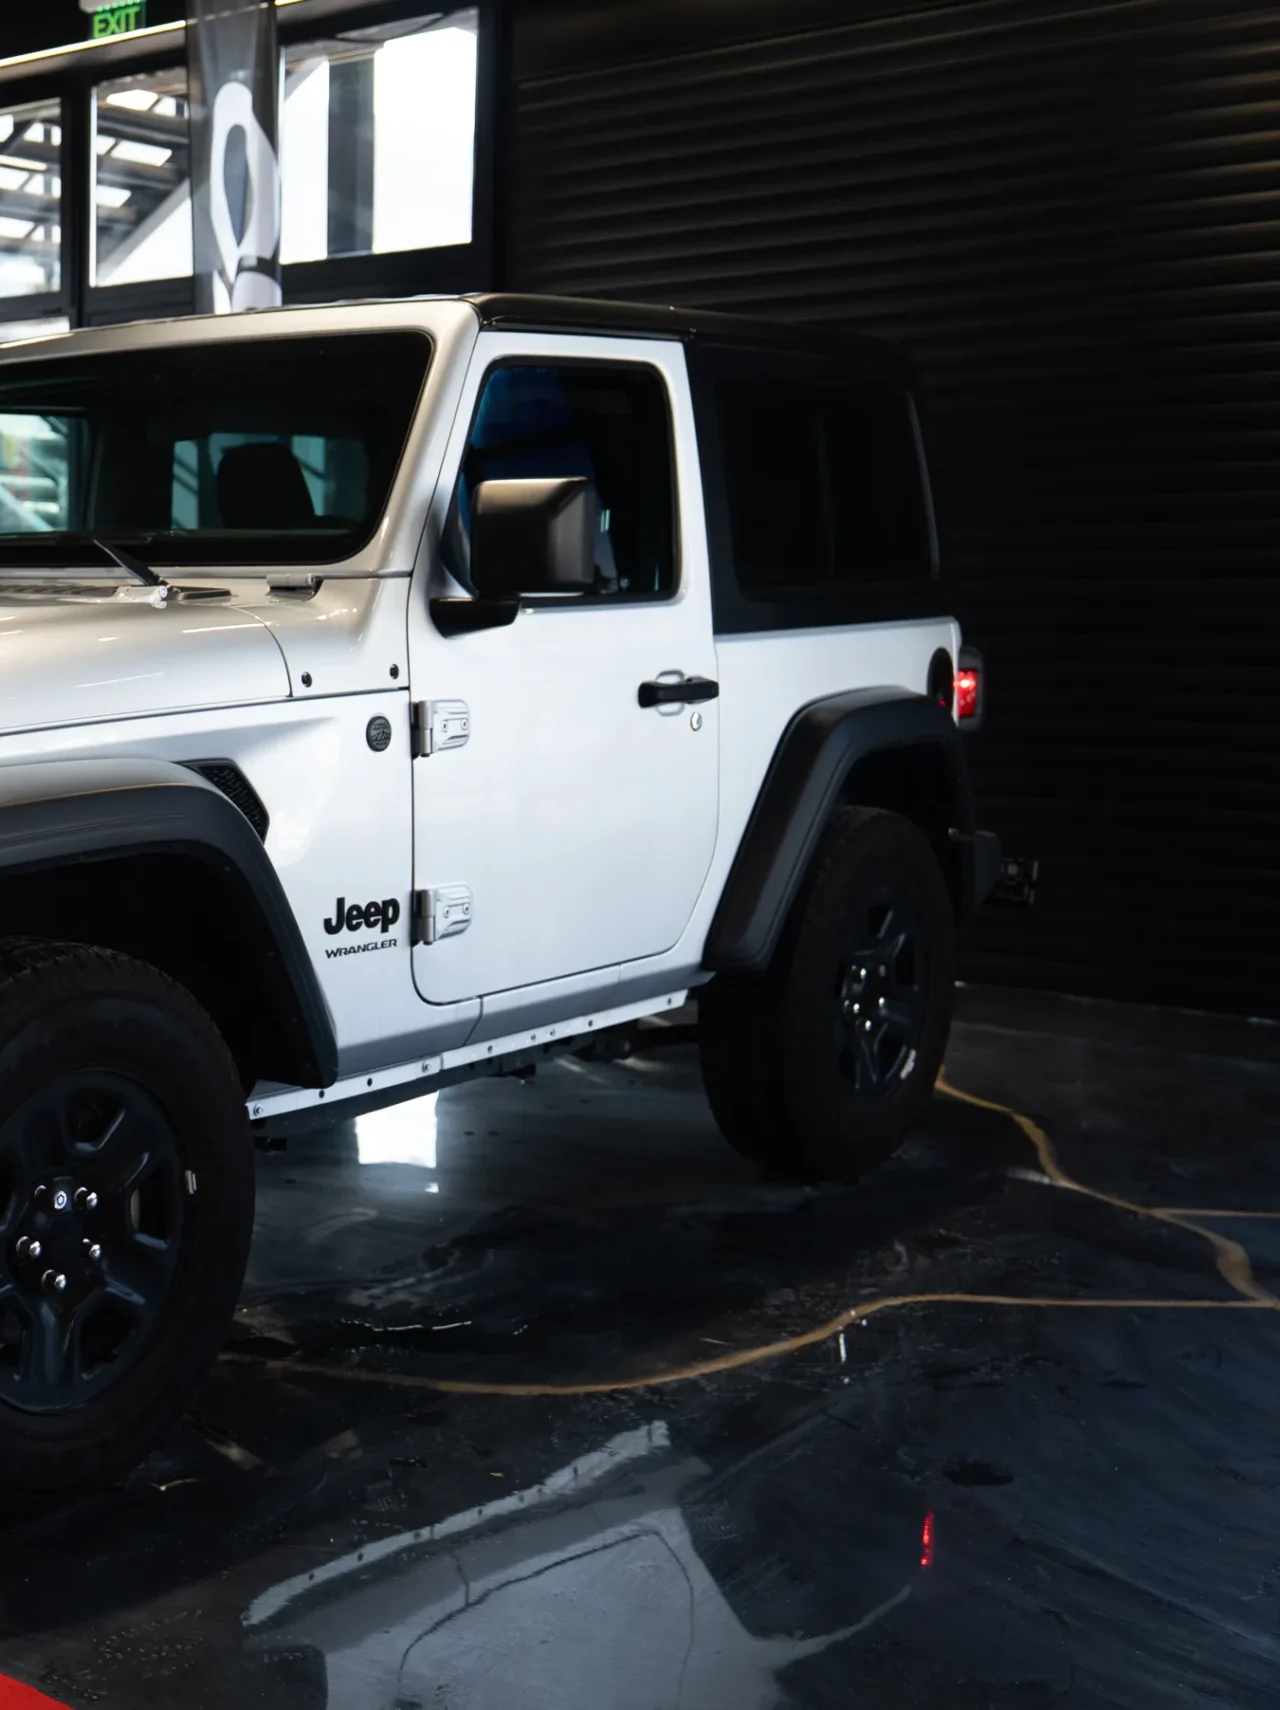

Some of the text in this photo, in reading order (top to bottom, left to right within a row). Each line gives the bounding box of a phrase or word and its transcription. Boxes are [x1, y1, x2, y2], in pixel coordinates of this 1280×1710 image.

[93, 5, 141, 39] EXIT
[323, 896, 400, 935] Jeep
[325, 938, 398, 959] WRANGLER
